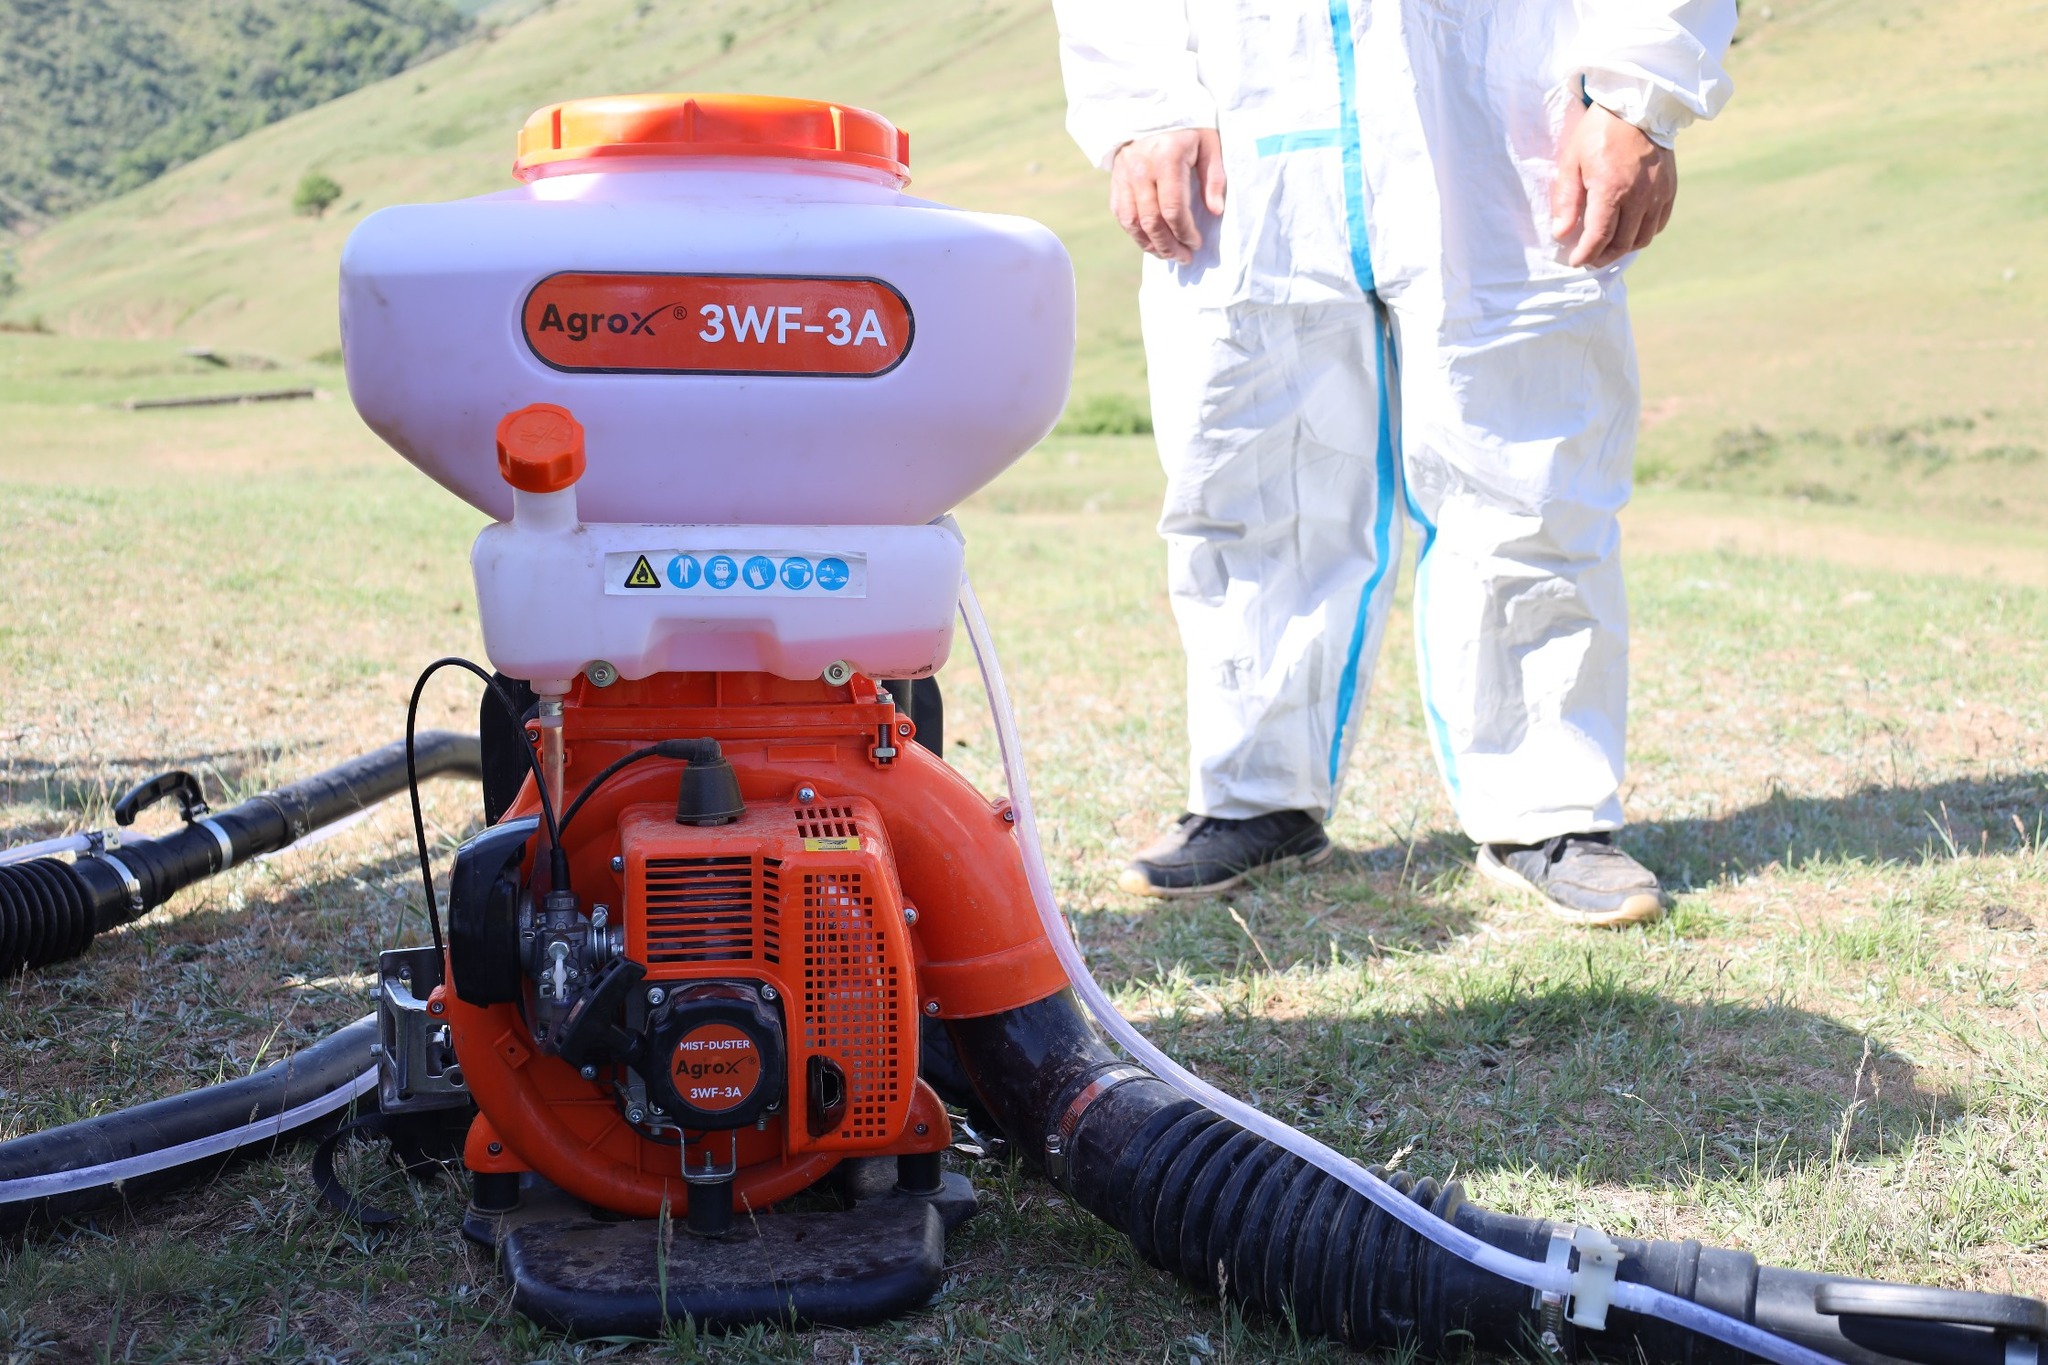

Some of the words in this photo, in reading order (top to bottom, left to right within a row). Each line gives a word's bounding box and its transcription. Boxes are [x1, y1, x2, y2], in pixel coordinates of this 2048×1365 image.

[538, 301, 683, 342] Agrox
[699, 303, 888, 347] 3WF-3A
[680, 1040, 750, 1051] MIST-DUSTER
[675, 1055, 750, 1079] Agrox
[690, 1086, 742, 1099] 3WF-3A
